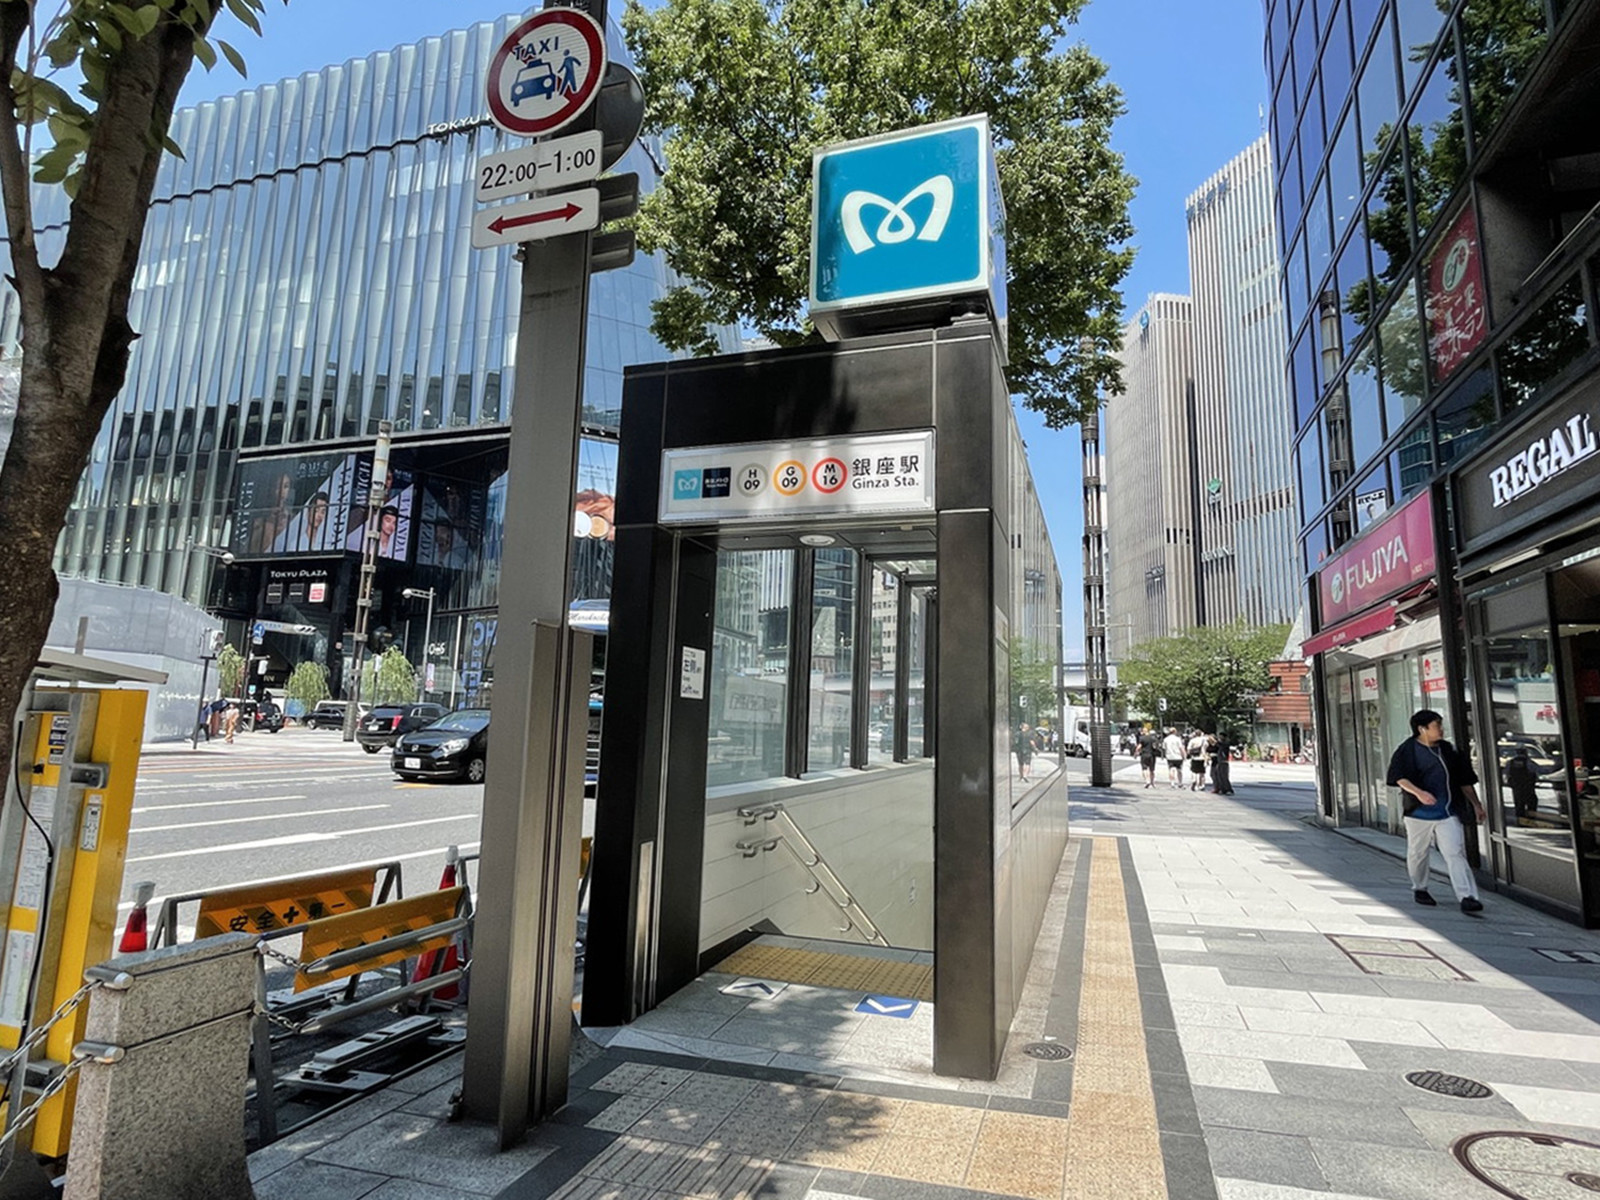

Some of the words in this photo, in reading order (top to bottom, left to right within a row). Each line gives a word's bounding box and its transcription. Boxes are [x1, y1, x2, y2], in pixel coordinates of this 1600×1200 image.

[514, 36, 559, 61] TAXI
[428, 115, 480, 134] TOKYU
[852, 455, 919, 476] 銀座駅
[1489, 413, 1596, 508] REGAL
[749, 469, 757, 478] H
[786, 466, 795, 476] G
[825, 464, 836, 474] M
[744, 480, 760, 490] 09
[782, 477, 798, 488] 09
[823, 475, 838, 485] 16
[852, 478, 889, 489] Ginza
[894, 476, 919, 487] Sta.
[1345, 534, 1409, 595] FUJIYA
[270, 570, 298, 578] TOKYU
[299, 569, 328, 577] PLAZA
[229, 912, 276, 933] 安全
